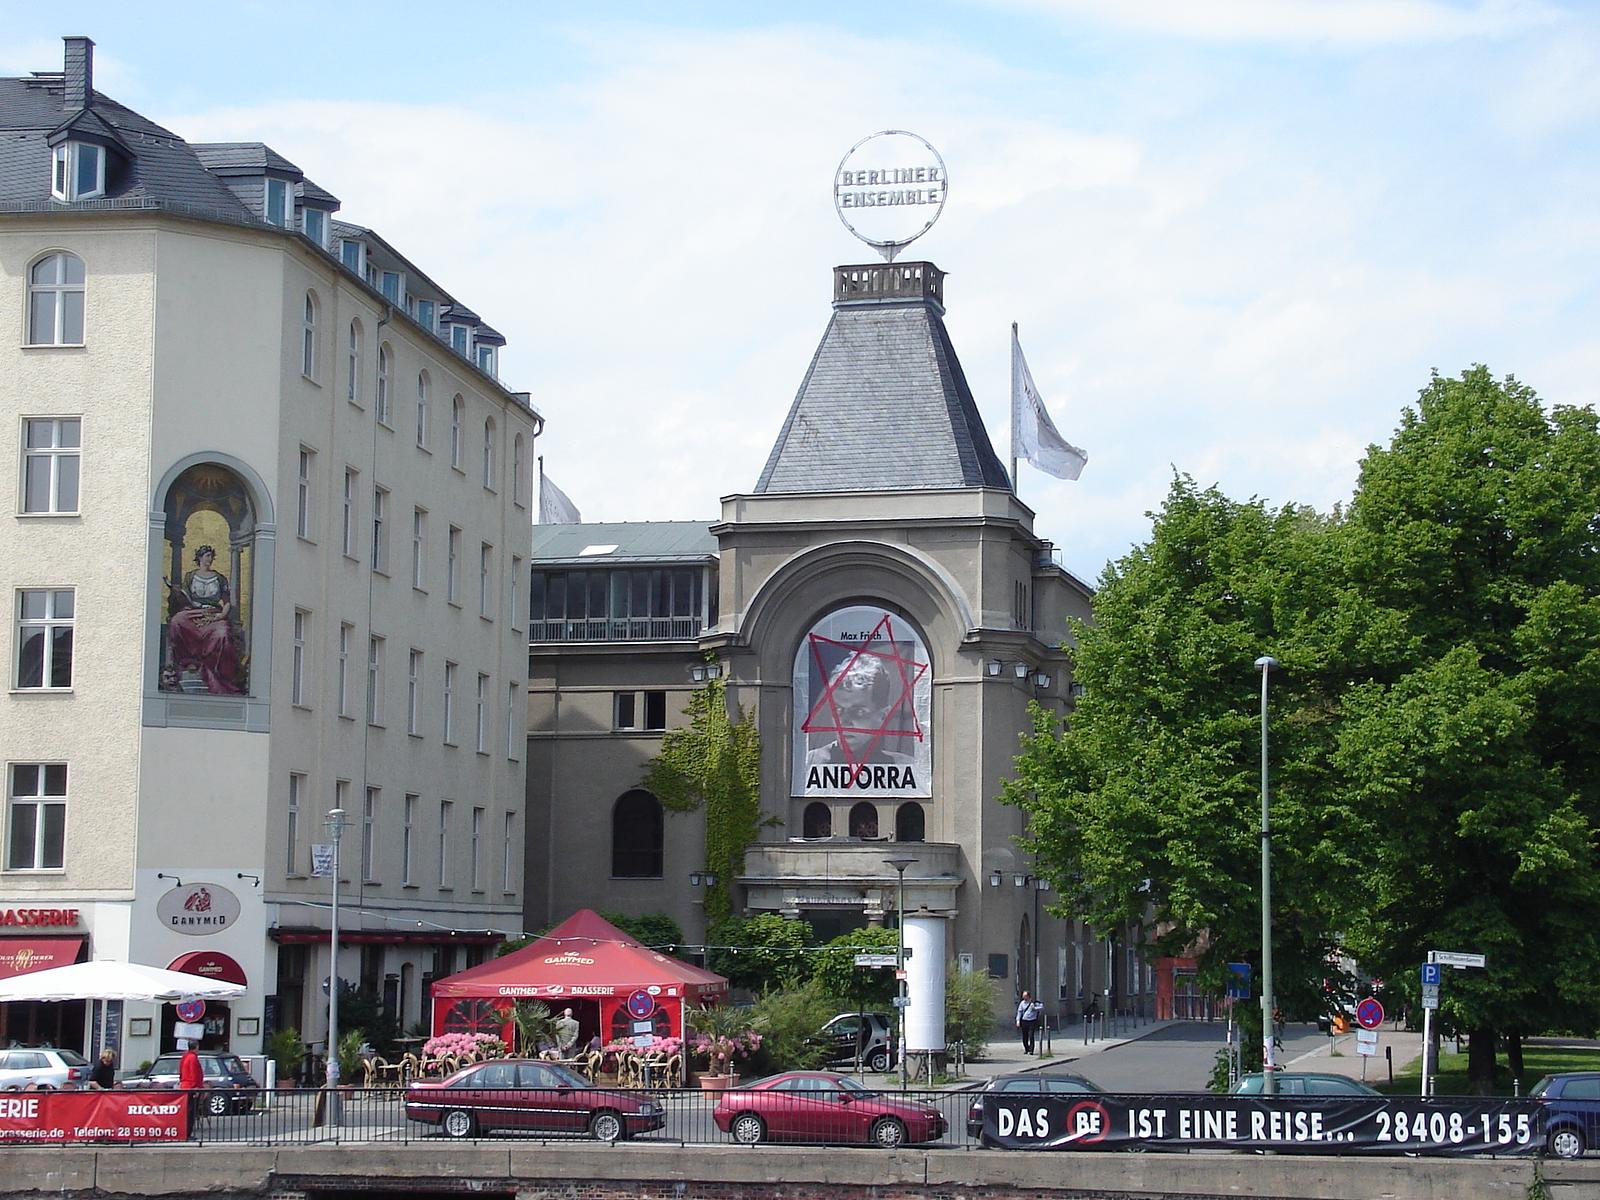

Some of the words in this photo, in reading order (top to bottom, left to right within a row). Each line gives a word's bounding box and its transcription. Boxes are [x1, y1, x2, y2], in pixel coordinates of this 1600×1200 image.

[842, 167, 938, 186] BERLINER
[842, 188, 938, 208] ENSEMBLE
[841, 631, 857, 640] Max
[860, 631, 882, 640] Frich
[806, 766, 917, 789] ANDORRA
[172, 915, 226, 925] GANYMED
[544, 956, 595, 965] GANYMED
[1425, 965, 1436, 982] P
[499, 986, 537, 995] GANYMED
[571, 986, 615, 995] BRASSERIE
[0, 1098, 39, 1118] ERIE
[127, 1105, 179, 1115] RICARD
[73, 1127, 115, 1137] Telefon:
[117, 1127, 131, 1137] 28
[133, 1127, 146, 1137] 59
[148, 1127, 162, 1137] 90
[164, 1127, 178, 1137] 46
[998, 1108, 1049, 1137] DAS
[1076, 1111, 1100, 1135] BE
[1128, 1109, 1166, 1138] IST
[1179, 1109, 1237, 1140] EINE
[1251, 1111, 1354, 1142] REISE...
[1376, 1111, 1530, 1144] 28408-155
